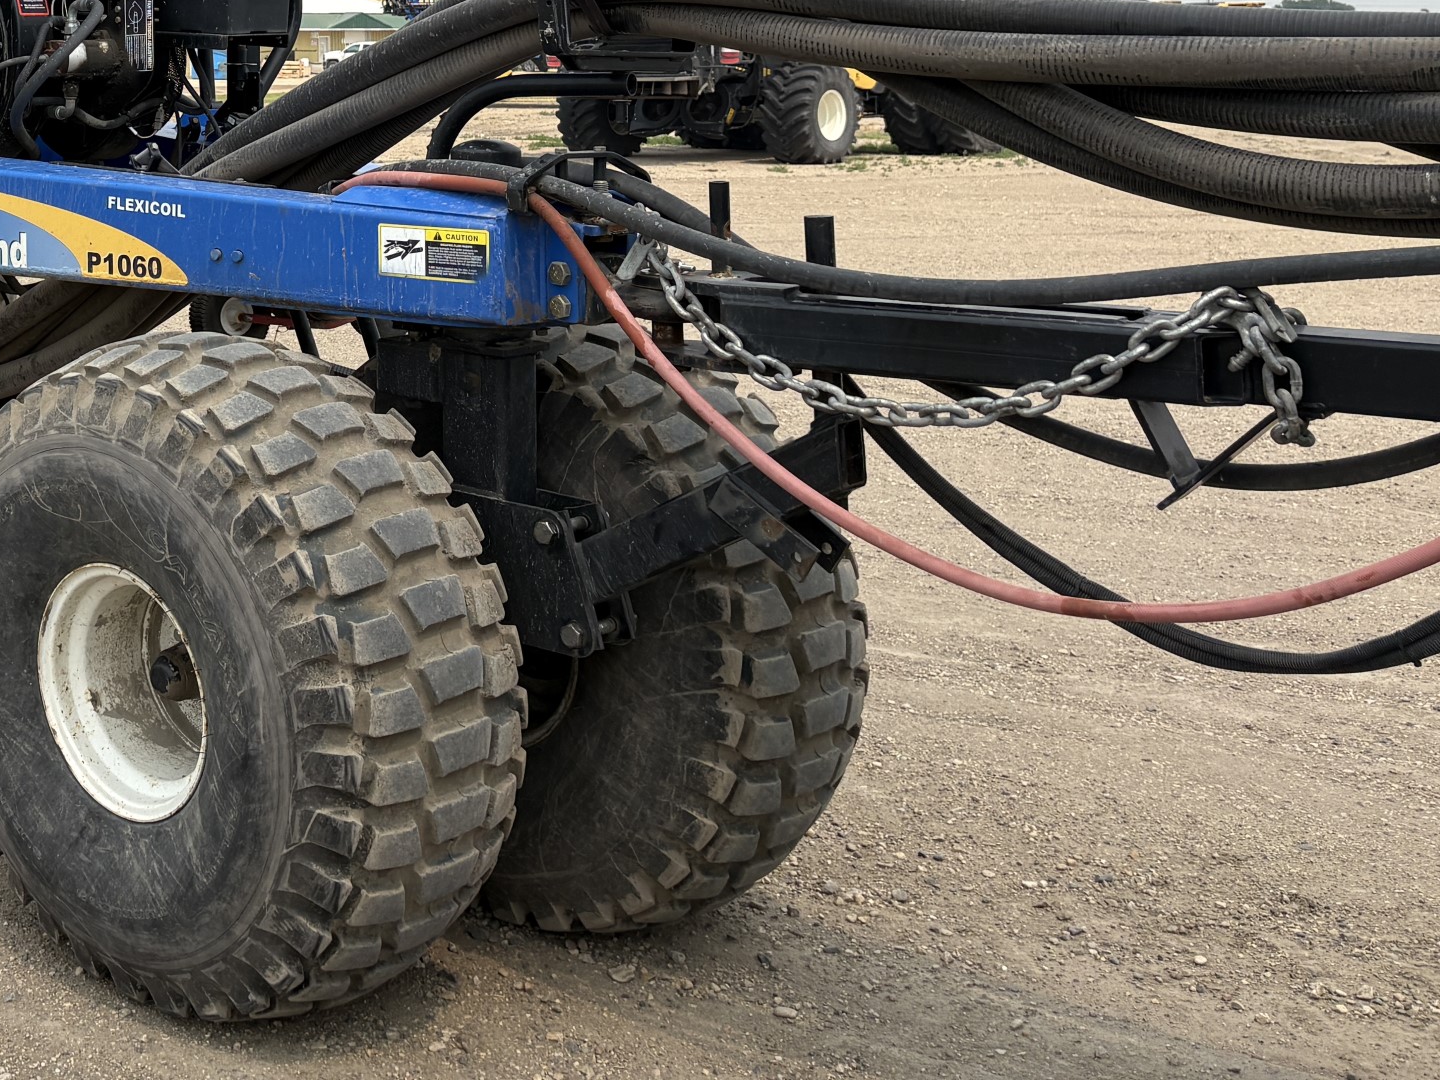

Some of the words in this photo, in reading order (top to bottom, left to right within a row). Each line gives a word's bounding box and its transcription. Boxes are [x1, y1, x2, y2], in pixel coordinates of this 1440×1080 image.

[107, 195, 186, 219] FLEXICOIL
[445, 233, 479, 242] CAUTION
[86, 251, 163, 279] P1060
